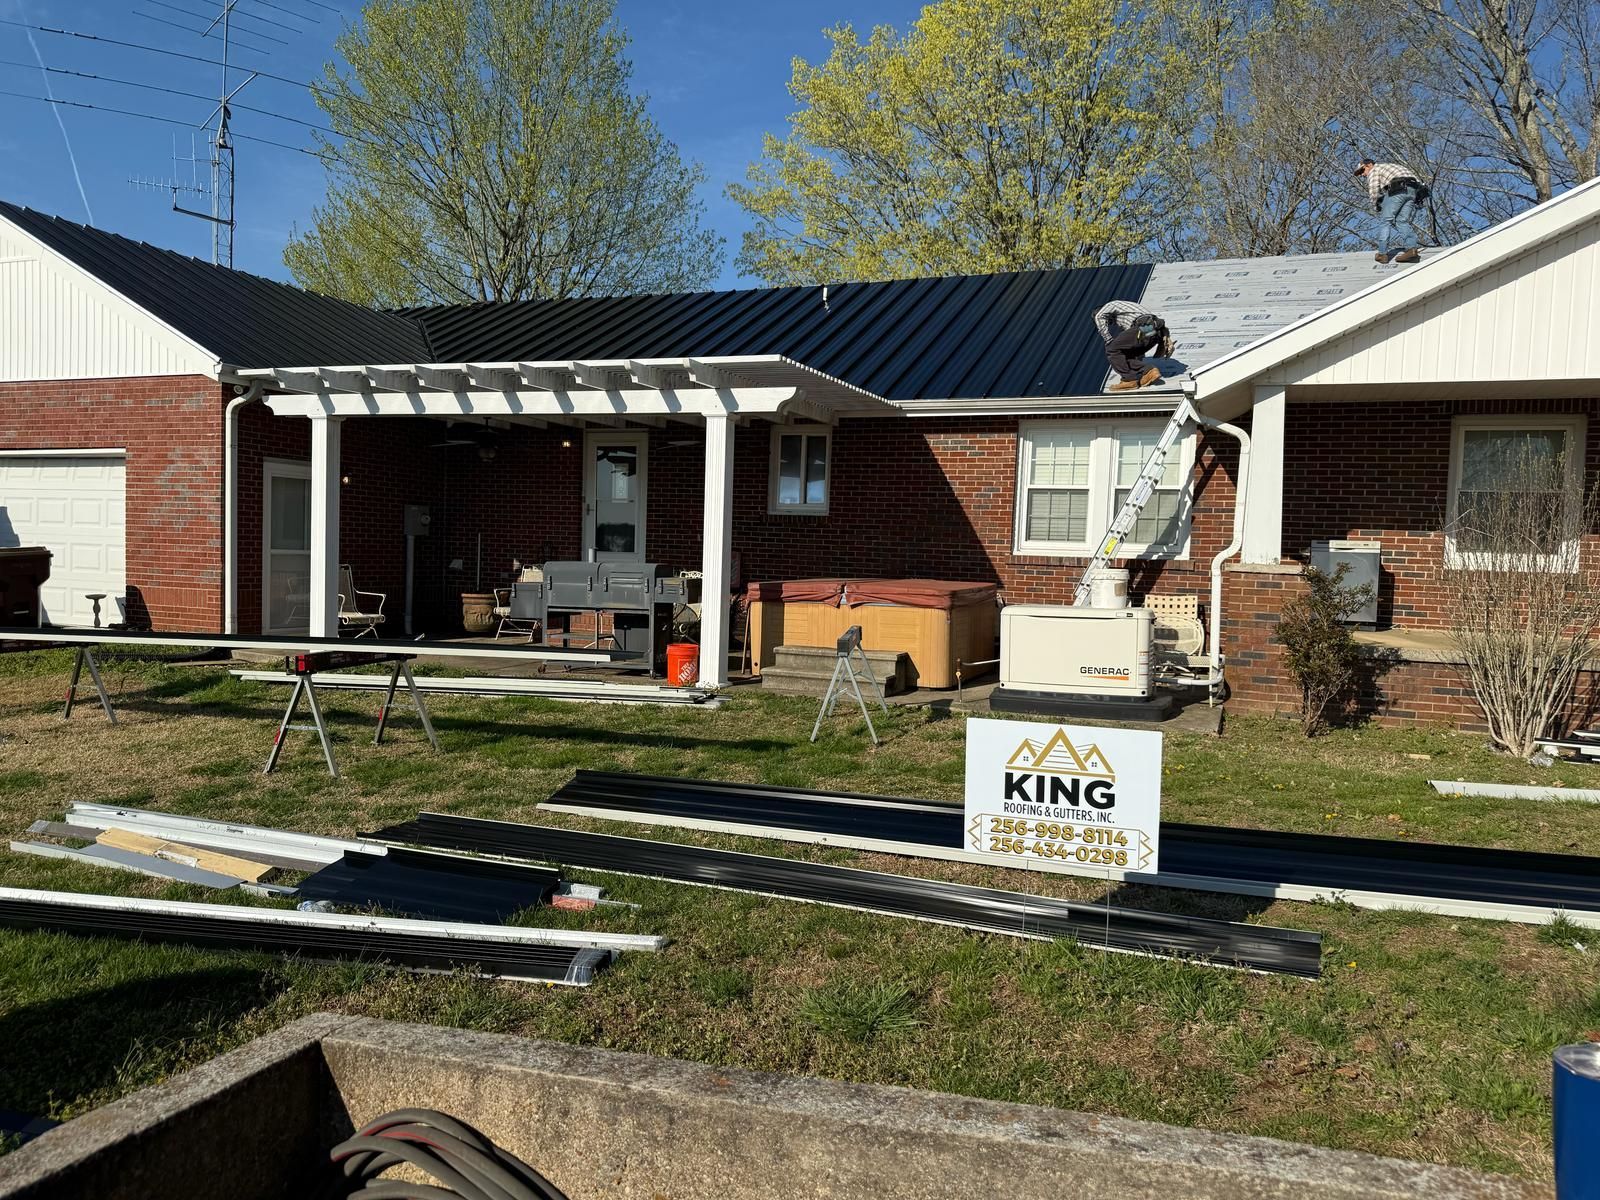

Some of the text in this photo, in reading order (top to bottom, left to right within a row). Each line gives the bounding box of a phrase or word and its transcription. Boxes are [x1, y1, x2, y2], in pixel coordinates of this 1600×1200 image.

[1080, 666, 1129, 676] GENERAC
[1004, 772, 1116, 810] KING
[1004, 802, 1115, 824] ROOFING & GUTTERS, INC.
[990, 817, 1128, 847] 256-998-8114
[989, 836, 1128, 866] 256-434-0298
